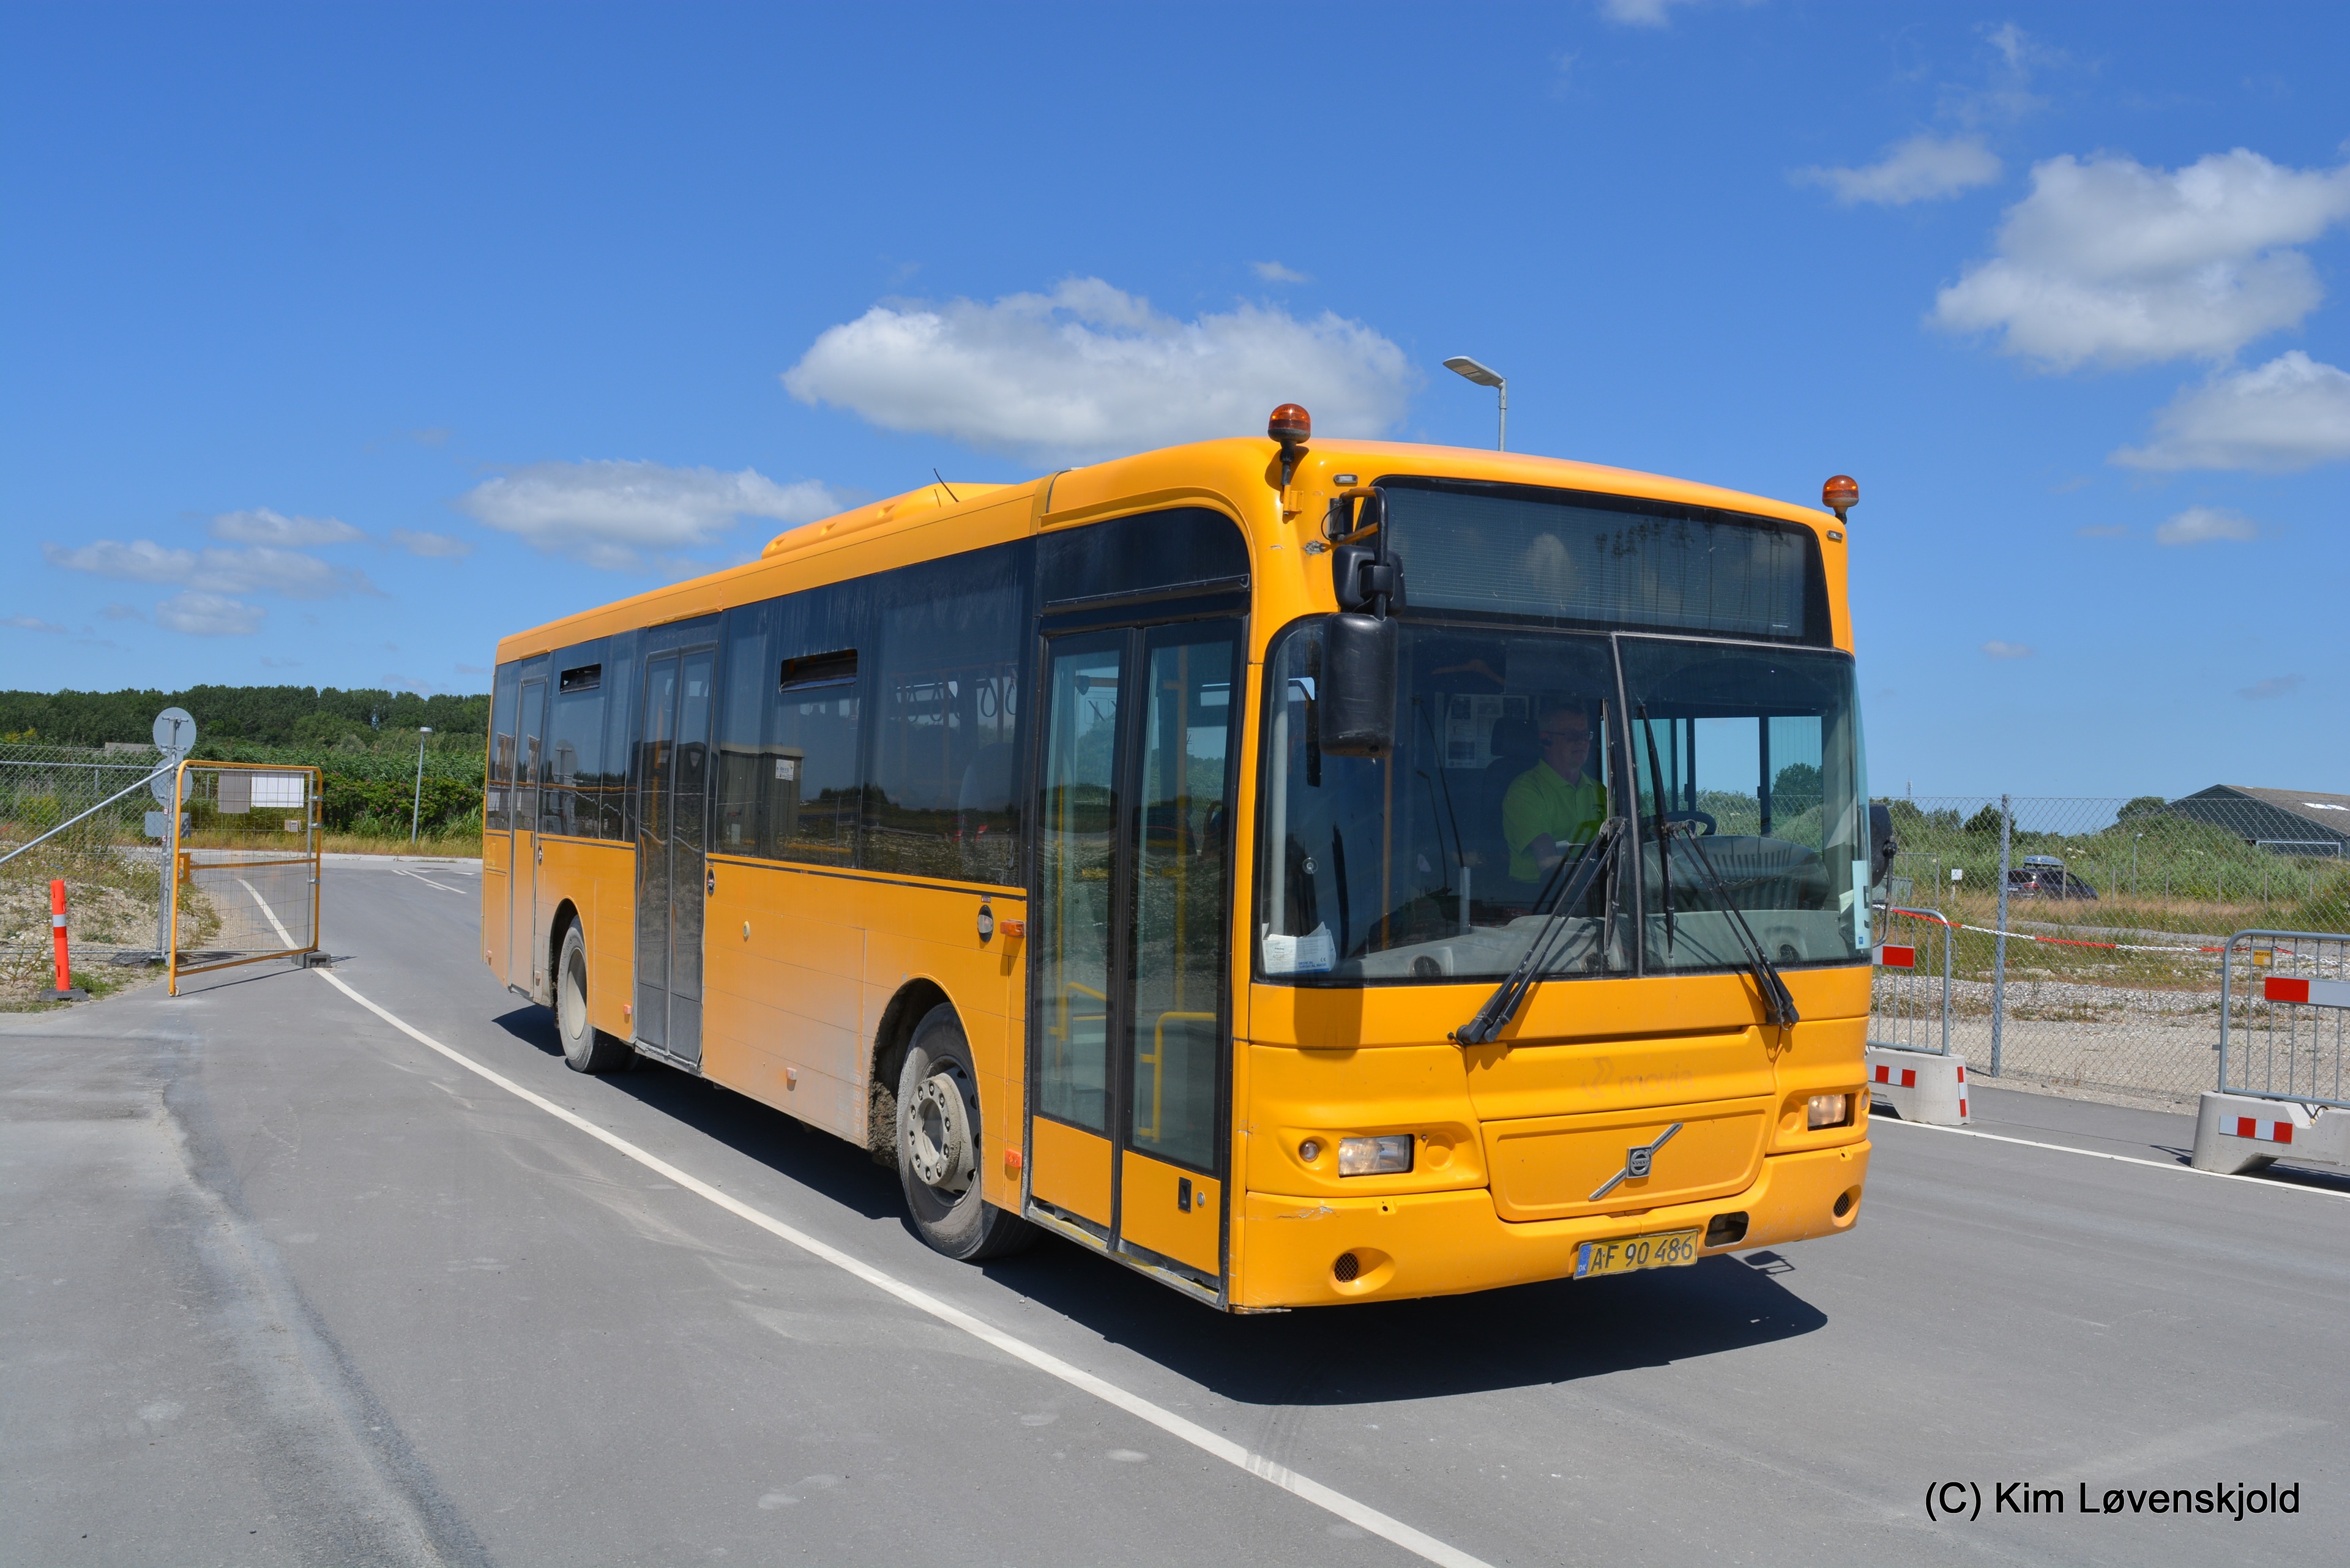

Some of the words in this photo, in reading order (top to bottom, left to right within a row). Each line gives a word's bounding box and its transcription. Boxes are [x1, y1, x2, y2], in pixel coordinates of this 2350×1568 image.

[1619, 1063, 1695, 1096] movia
[1590, 1245, 1619, 1272] AF
[1625, 1241, 1650, 1267] 90
[1654, 1235, 1693, 1262] 486
